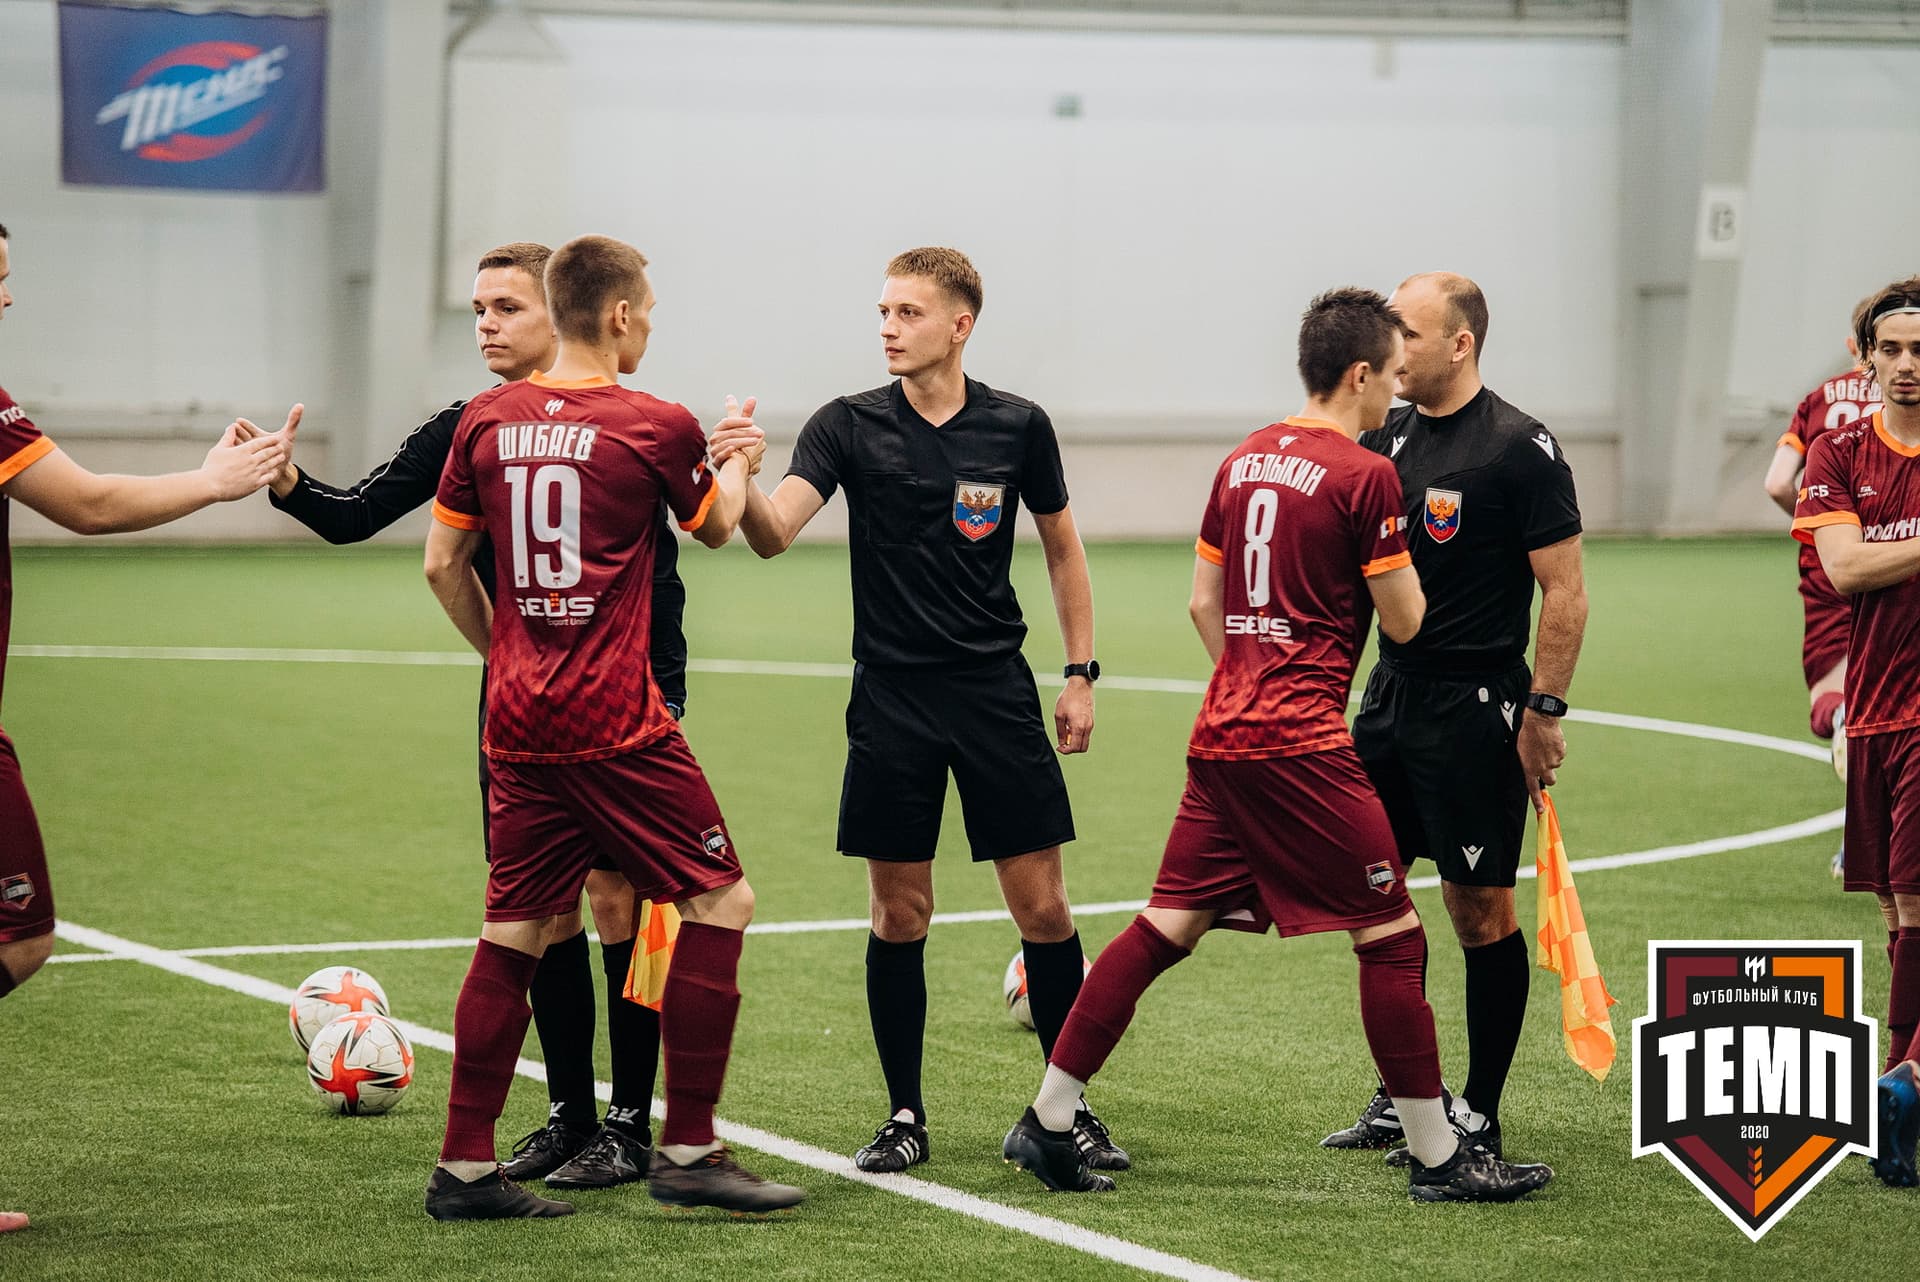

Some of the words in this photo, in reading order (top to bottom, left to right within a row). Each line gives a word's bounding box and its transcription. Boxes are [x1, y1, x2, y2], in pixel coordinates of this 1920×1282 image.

[1824, 378, 1882, 404] БОБЕШ
[498, 424, 597, 461] ШИБАЕВ
[1228, 452, 1328, 497] ЩЕБЛЫКИН
[504, 464, 582, 589] 19
[1243, 488, 1279, 608] 8
[1225, 614, 1292, 637] SEUS
